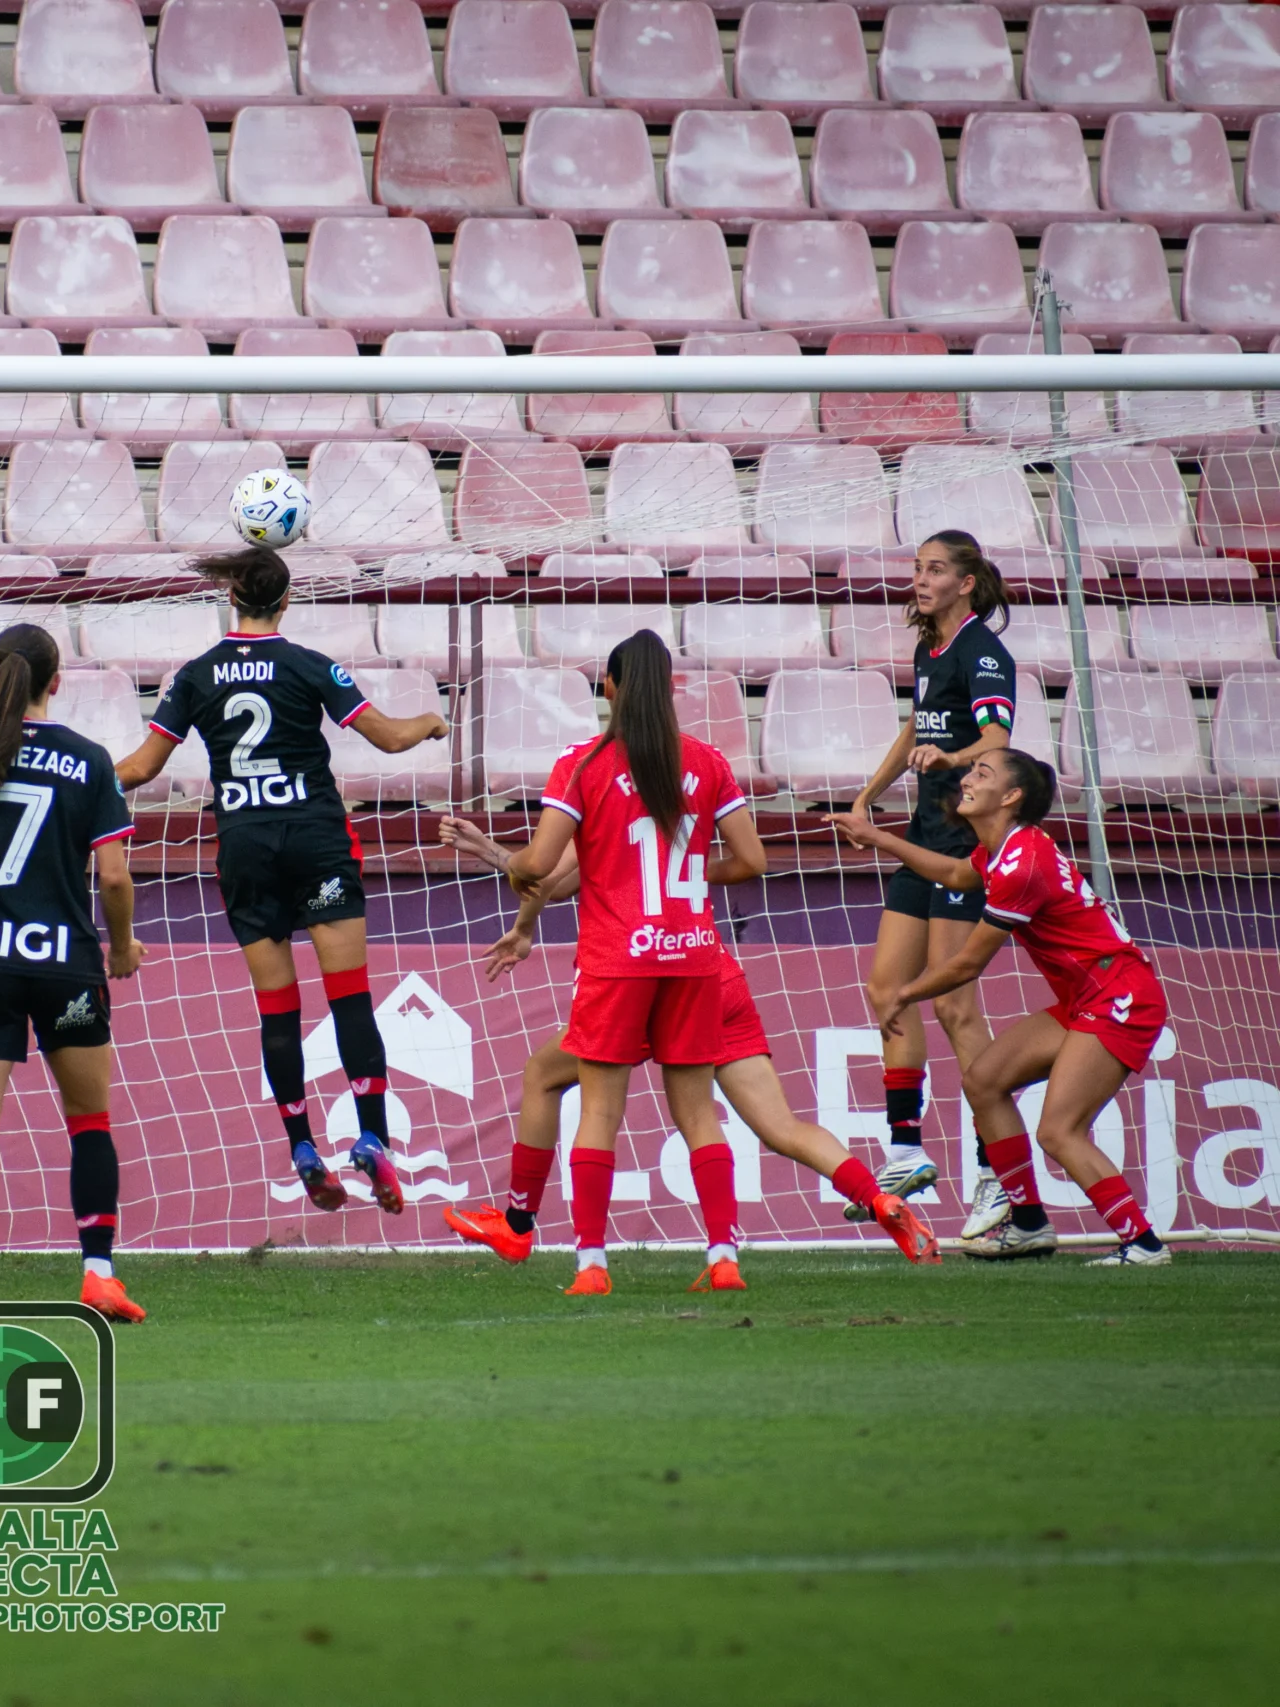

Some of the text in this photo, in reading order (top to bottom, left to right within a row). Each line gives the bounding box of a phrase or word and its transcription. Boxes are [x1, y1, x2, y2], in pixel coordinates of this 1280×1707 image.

[213, 661, 274, 685] MADDI
[224, 692, 282, 777] 2
[221, 773, 307, 811] DIGI
[629, 813, 708, 916] 14
